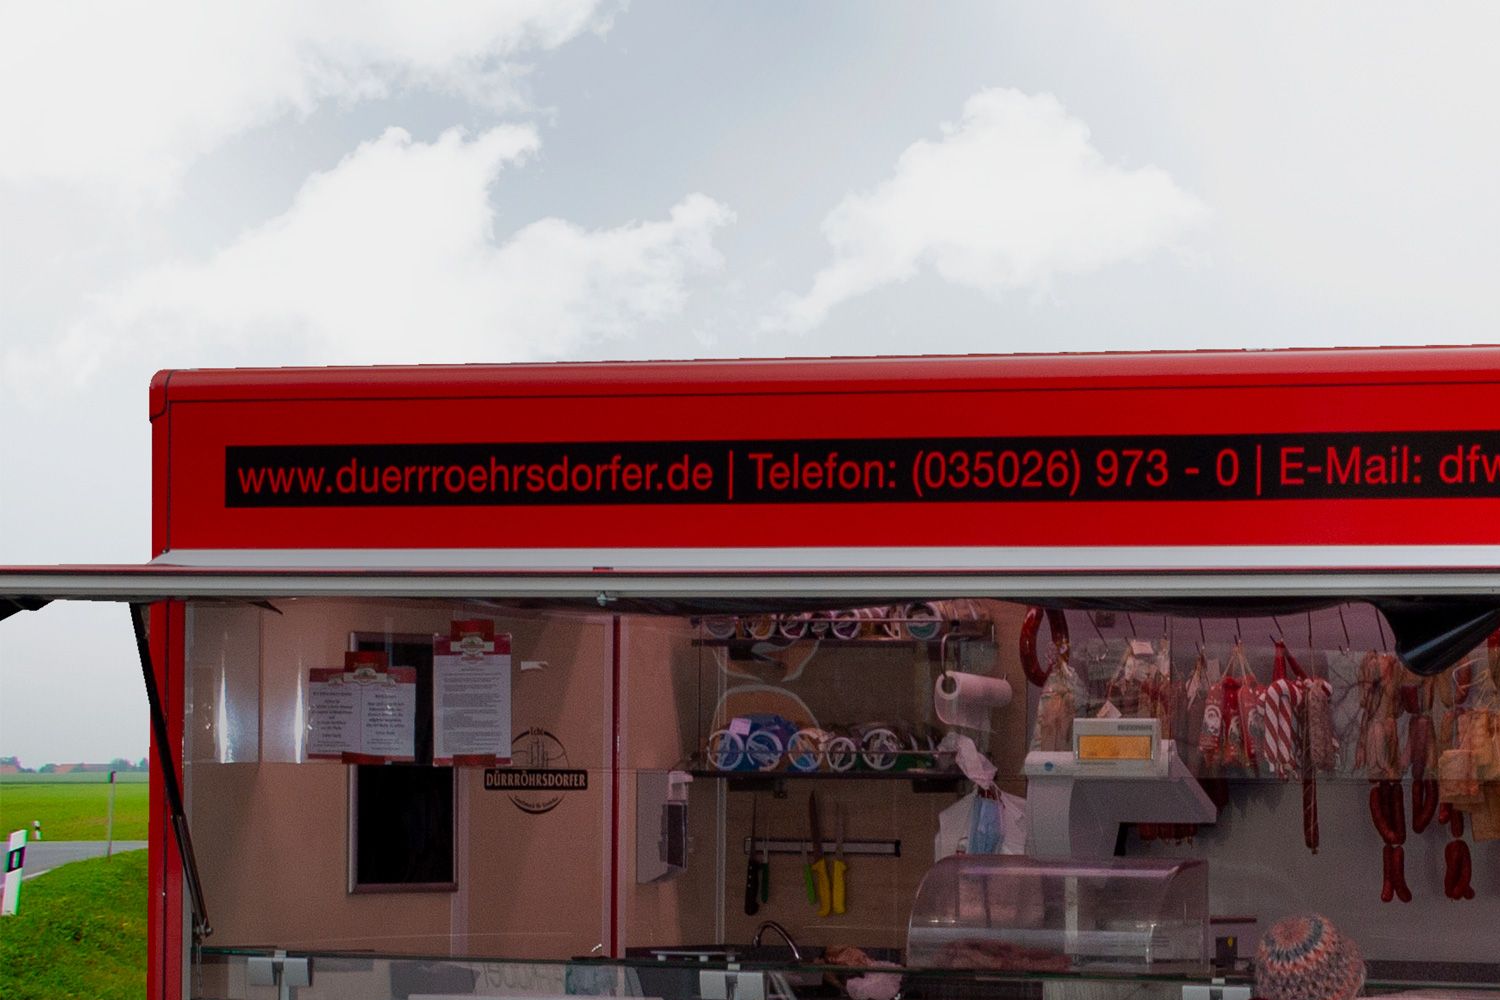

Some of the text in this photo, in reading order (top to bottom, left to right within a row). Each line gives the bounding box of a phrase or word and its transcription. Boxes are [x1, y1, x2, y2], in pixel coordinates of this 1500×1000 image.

[237, 454, 714, 494] www.duerrroehrsdorfer.de
[747, 451, 896, 491] Telefon:
[912, 448, 1081, 497] (035026)
[1095, 448, 1169, 488] 973
[1215, 447, 1240, 487] 0
[1279, 444, 1422, 486] E-Mail:
[485, 770, 587, 788] DÜRRRÖHRSDORFER
